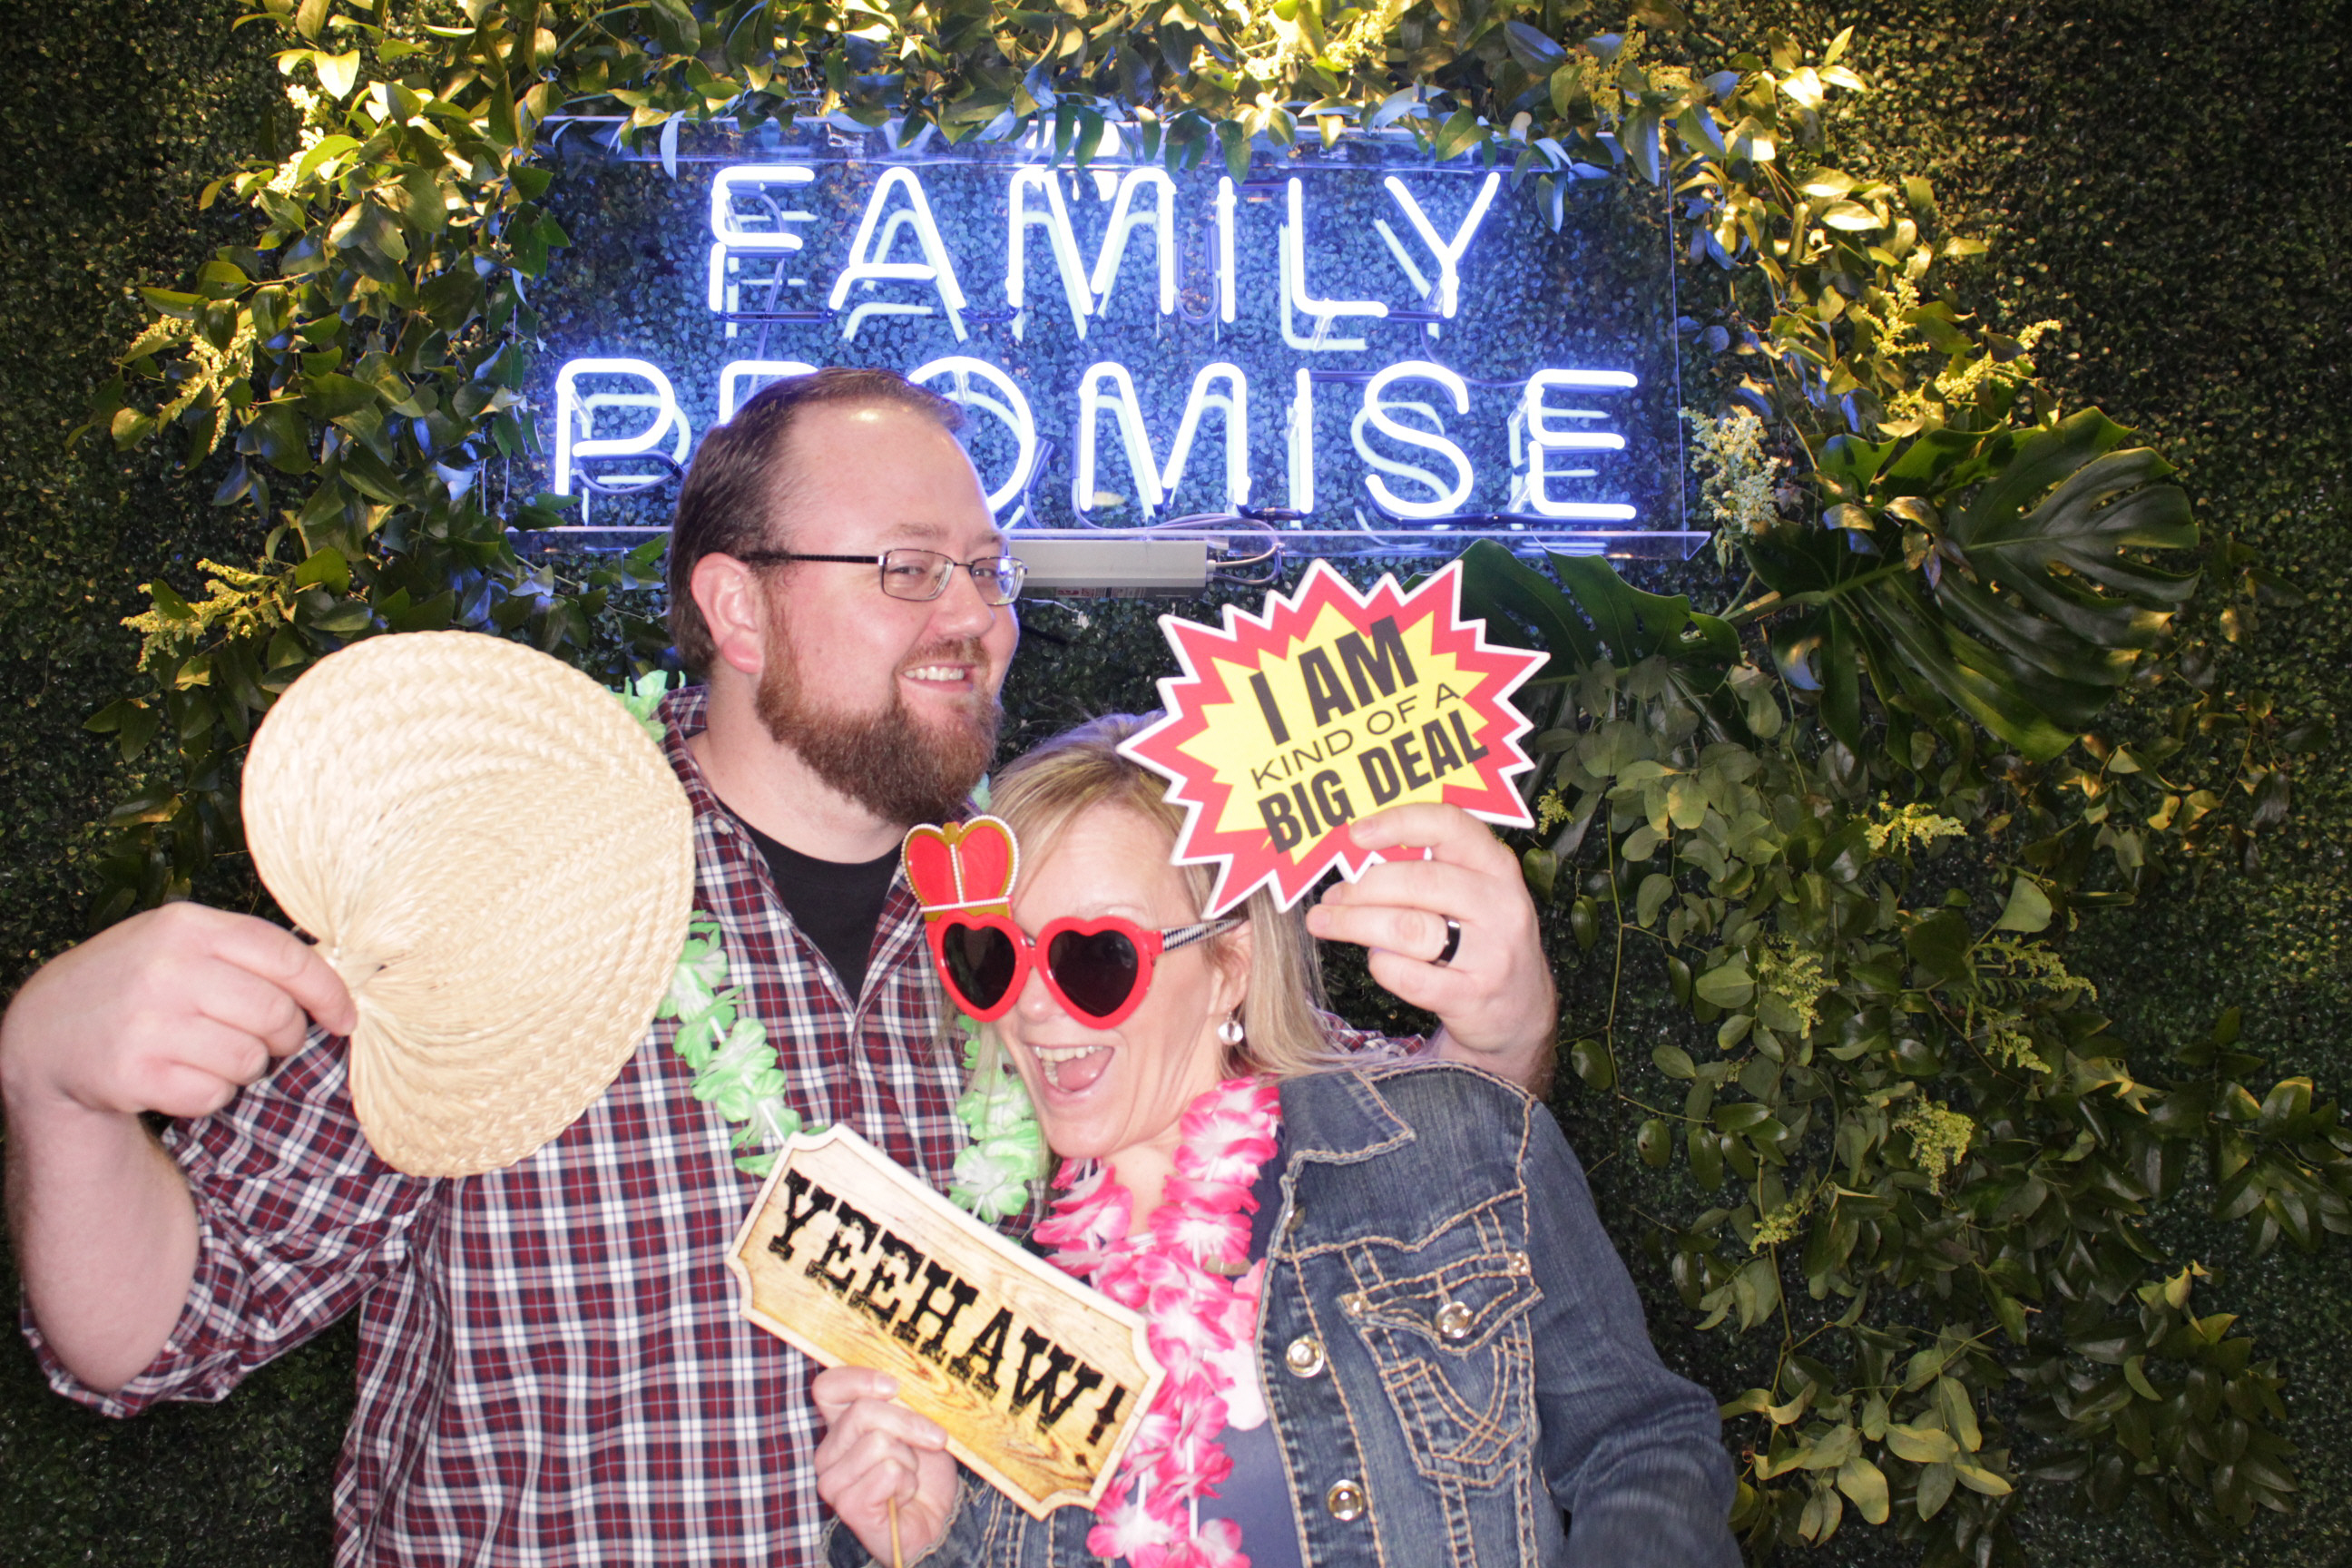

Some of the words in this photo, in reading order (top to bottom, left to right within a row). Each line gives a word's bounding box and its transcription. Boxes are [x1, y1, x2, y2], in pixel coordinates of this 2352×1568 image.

[709, 165, 1500, 323] FAMILY
[1248, 671, 1291, 746] I
[1298, 614, 1419, 728] AM
[1250, 729, 1353, 789] KIND
[1367, 695, 1418, 736] OF
[1436, 681, 1462, 709] A
[1257, 769, 1356, 854] BIG
[1357, 710, 1489, 807] DEAL
[768, 1167, 1126, 1446] YEEHAW!
